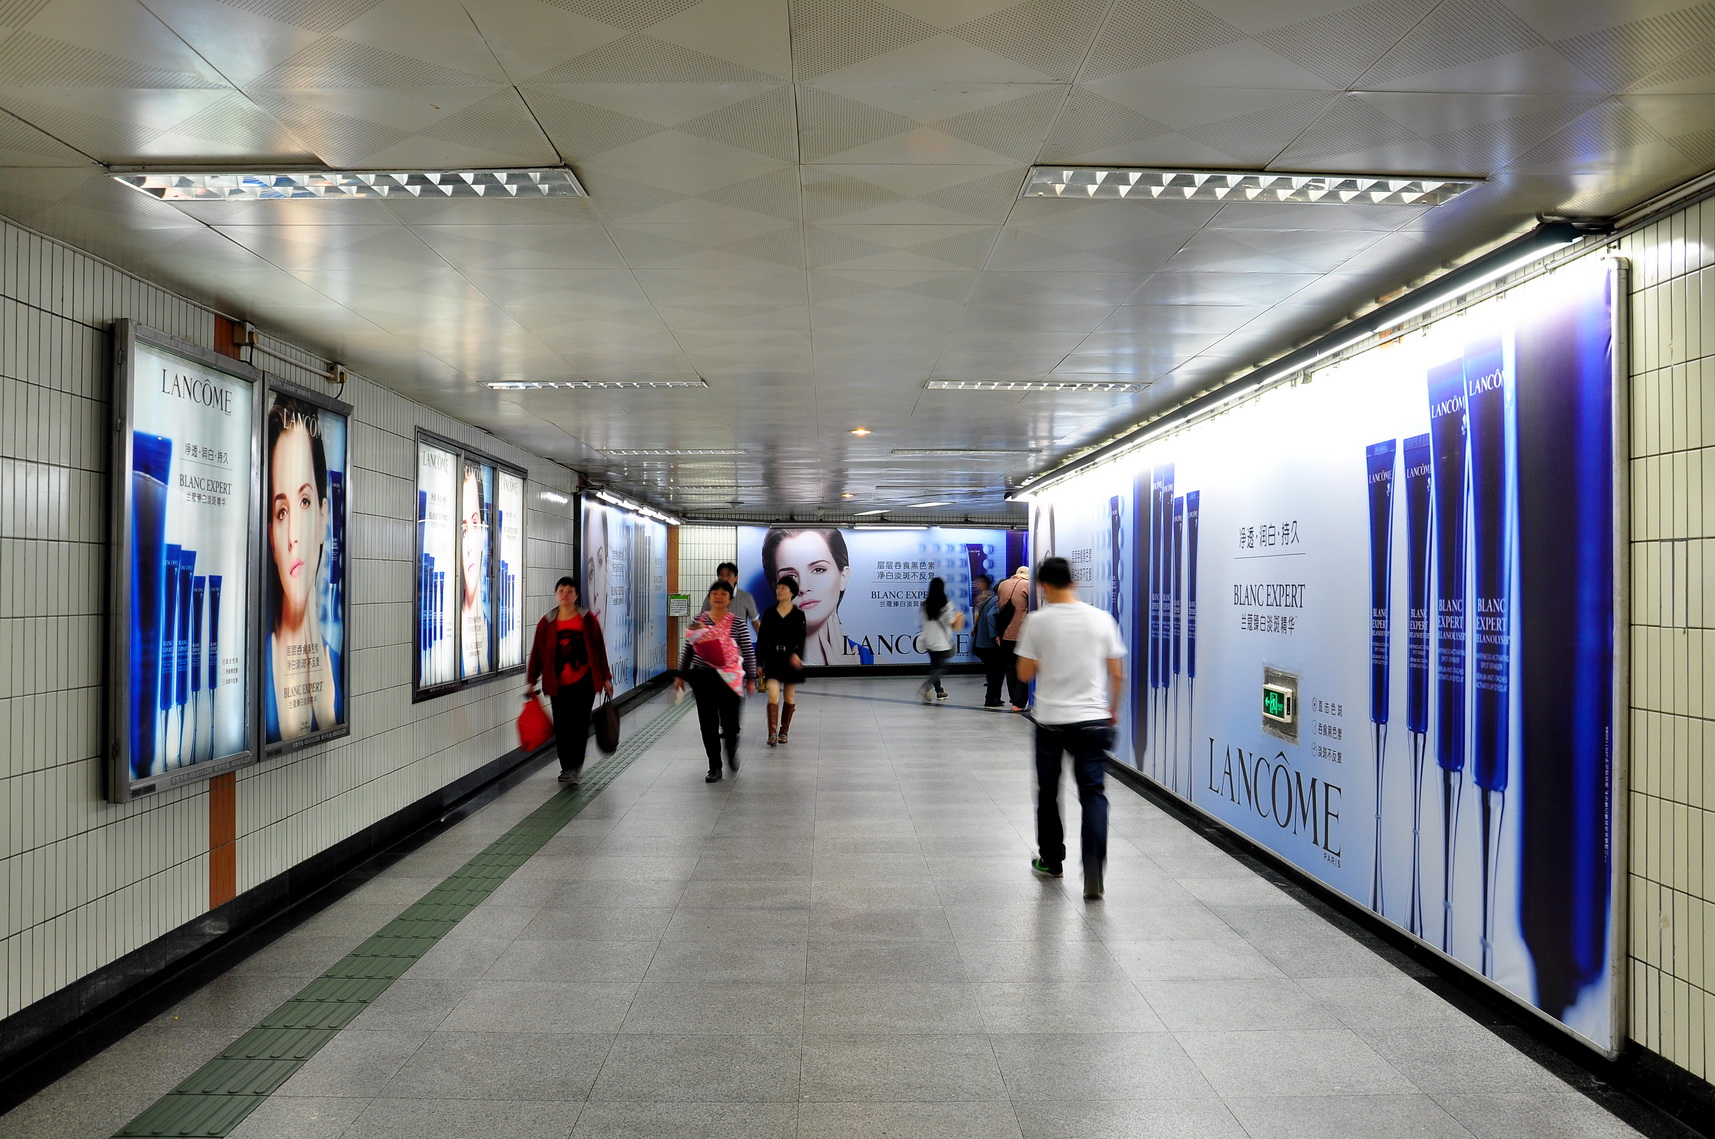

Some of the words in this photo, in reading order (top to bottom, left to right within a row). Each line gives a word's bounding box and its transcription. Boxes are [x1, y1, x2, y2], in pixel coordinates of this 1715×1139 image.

[162, 368, 233, 414] LANCÔME
[179, 473, 206, 494] BLANC
[206, 478, 233, 496] EXPERT
[877, 561, 935, 570] 层层吞食黑色素
[871, 591, 904, 599] BLANC
[905, 591, 929, 600] EXPE
[1233, 584, 1264, 606] BLANC
[1266, 584, 1306, 608] EXPERT
[1438, 598, 1463, 612] BLANC
[1477, 598, 1505, 613] BLANC
[1437, 615, 1464, 629] EXPERT
[1476, 616, 1507, 632] EXPERT
[283, 684, 302, 699] BLANC
[302, 681, 324, 696] EXPERT
[1208, 737, 1342, 858] LANCÔME
[1323, 852, 1342, 869] PARIS
